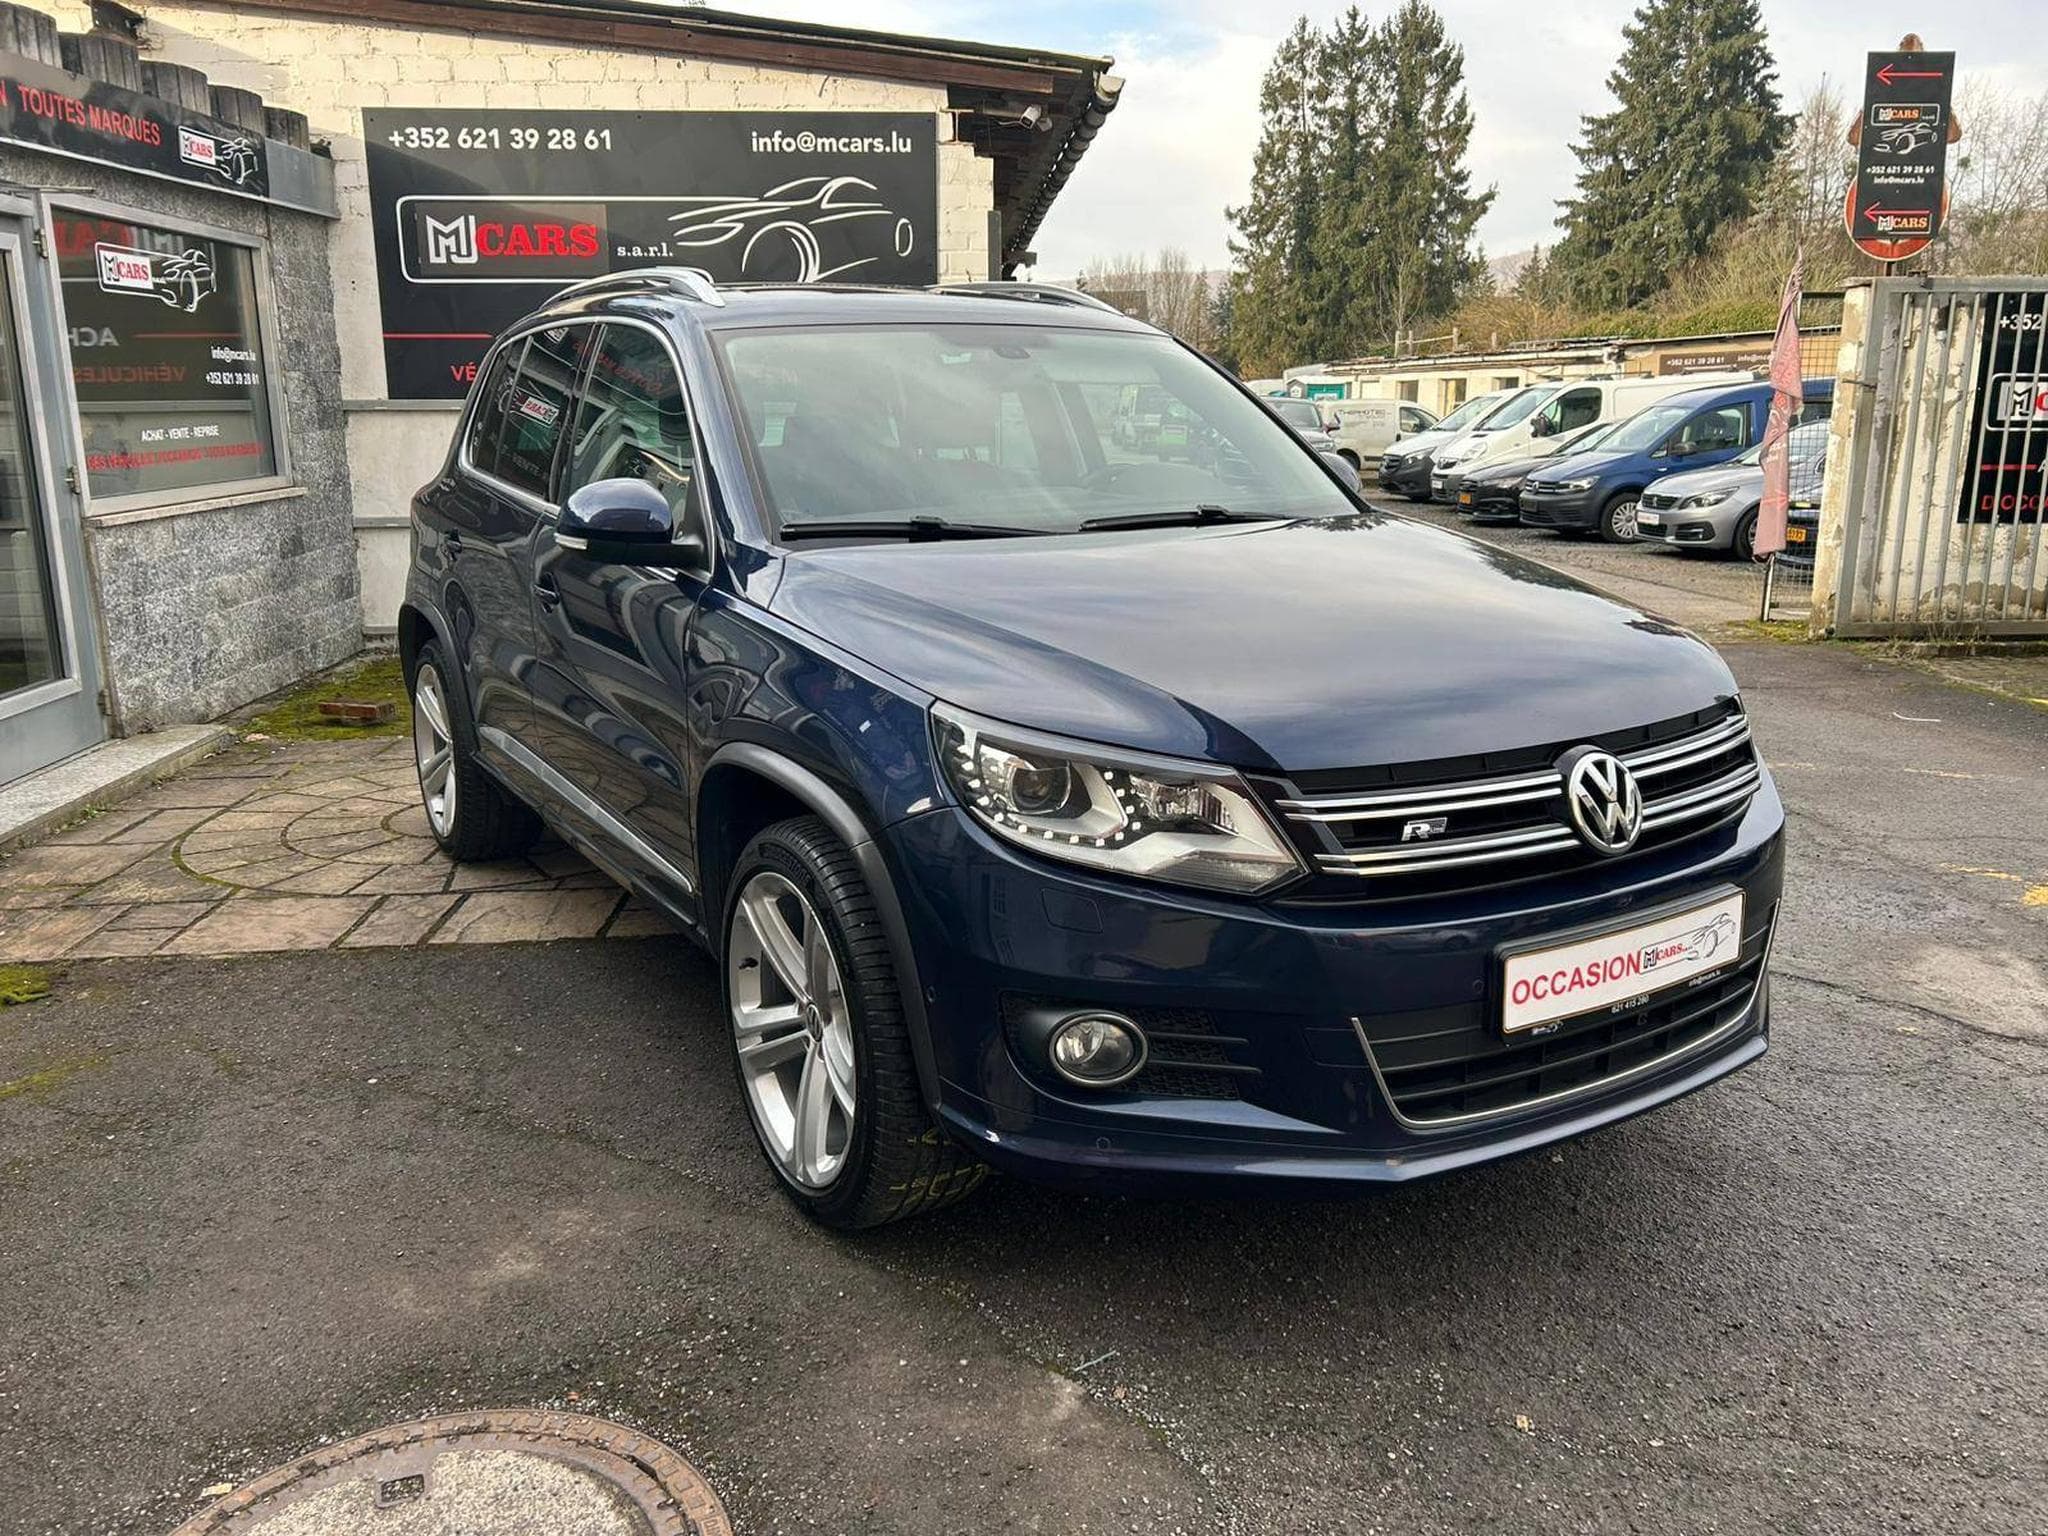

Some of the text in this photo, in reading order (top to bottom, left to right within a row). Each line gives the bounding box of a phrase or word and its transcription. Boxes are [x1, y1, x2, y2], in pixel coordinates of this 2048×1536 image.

[18, 83, 86, 127] TOUTES
[88, 103, 161, 147] MARQUES
[389, 127, 612, 150] +352 621 39 28 61
[752, 130, 912, 153] info@mcars.lu
[617, 243, 673, 257] s.a.r.l.
[1512, 950, 1641, 1005] OCCASION
